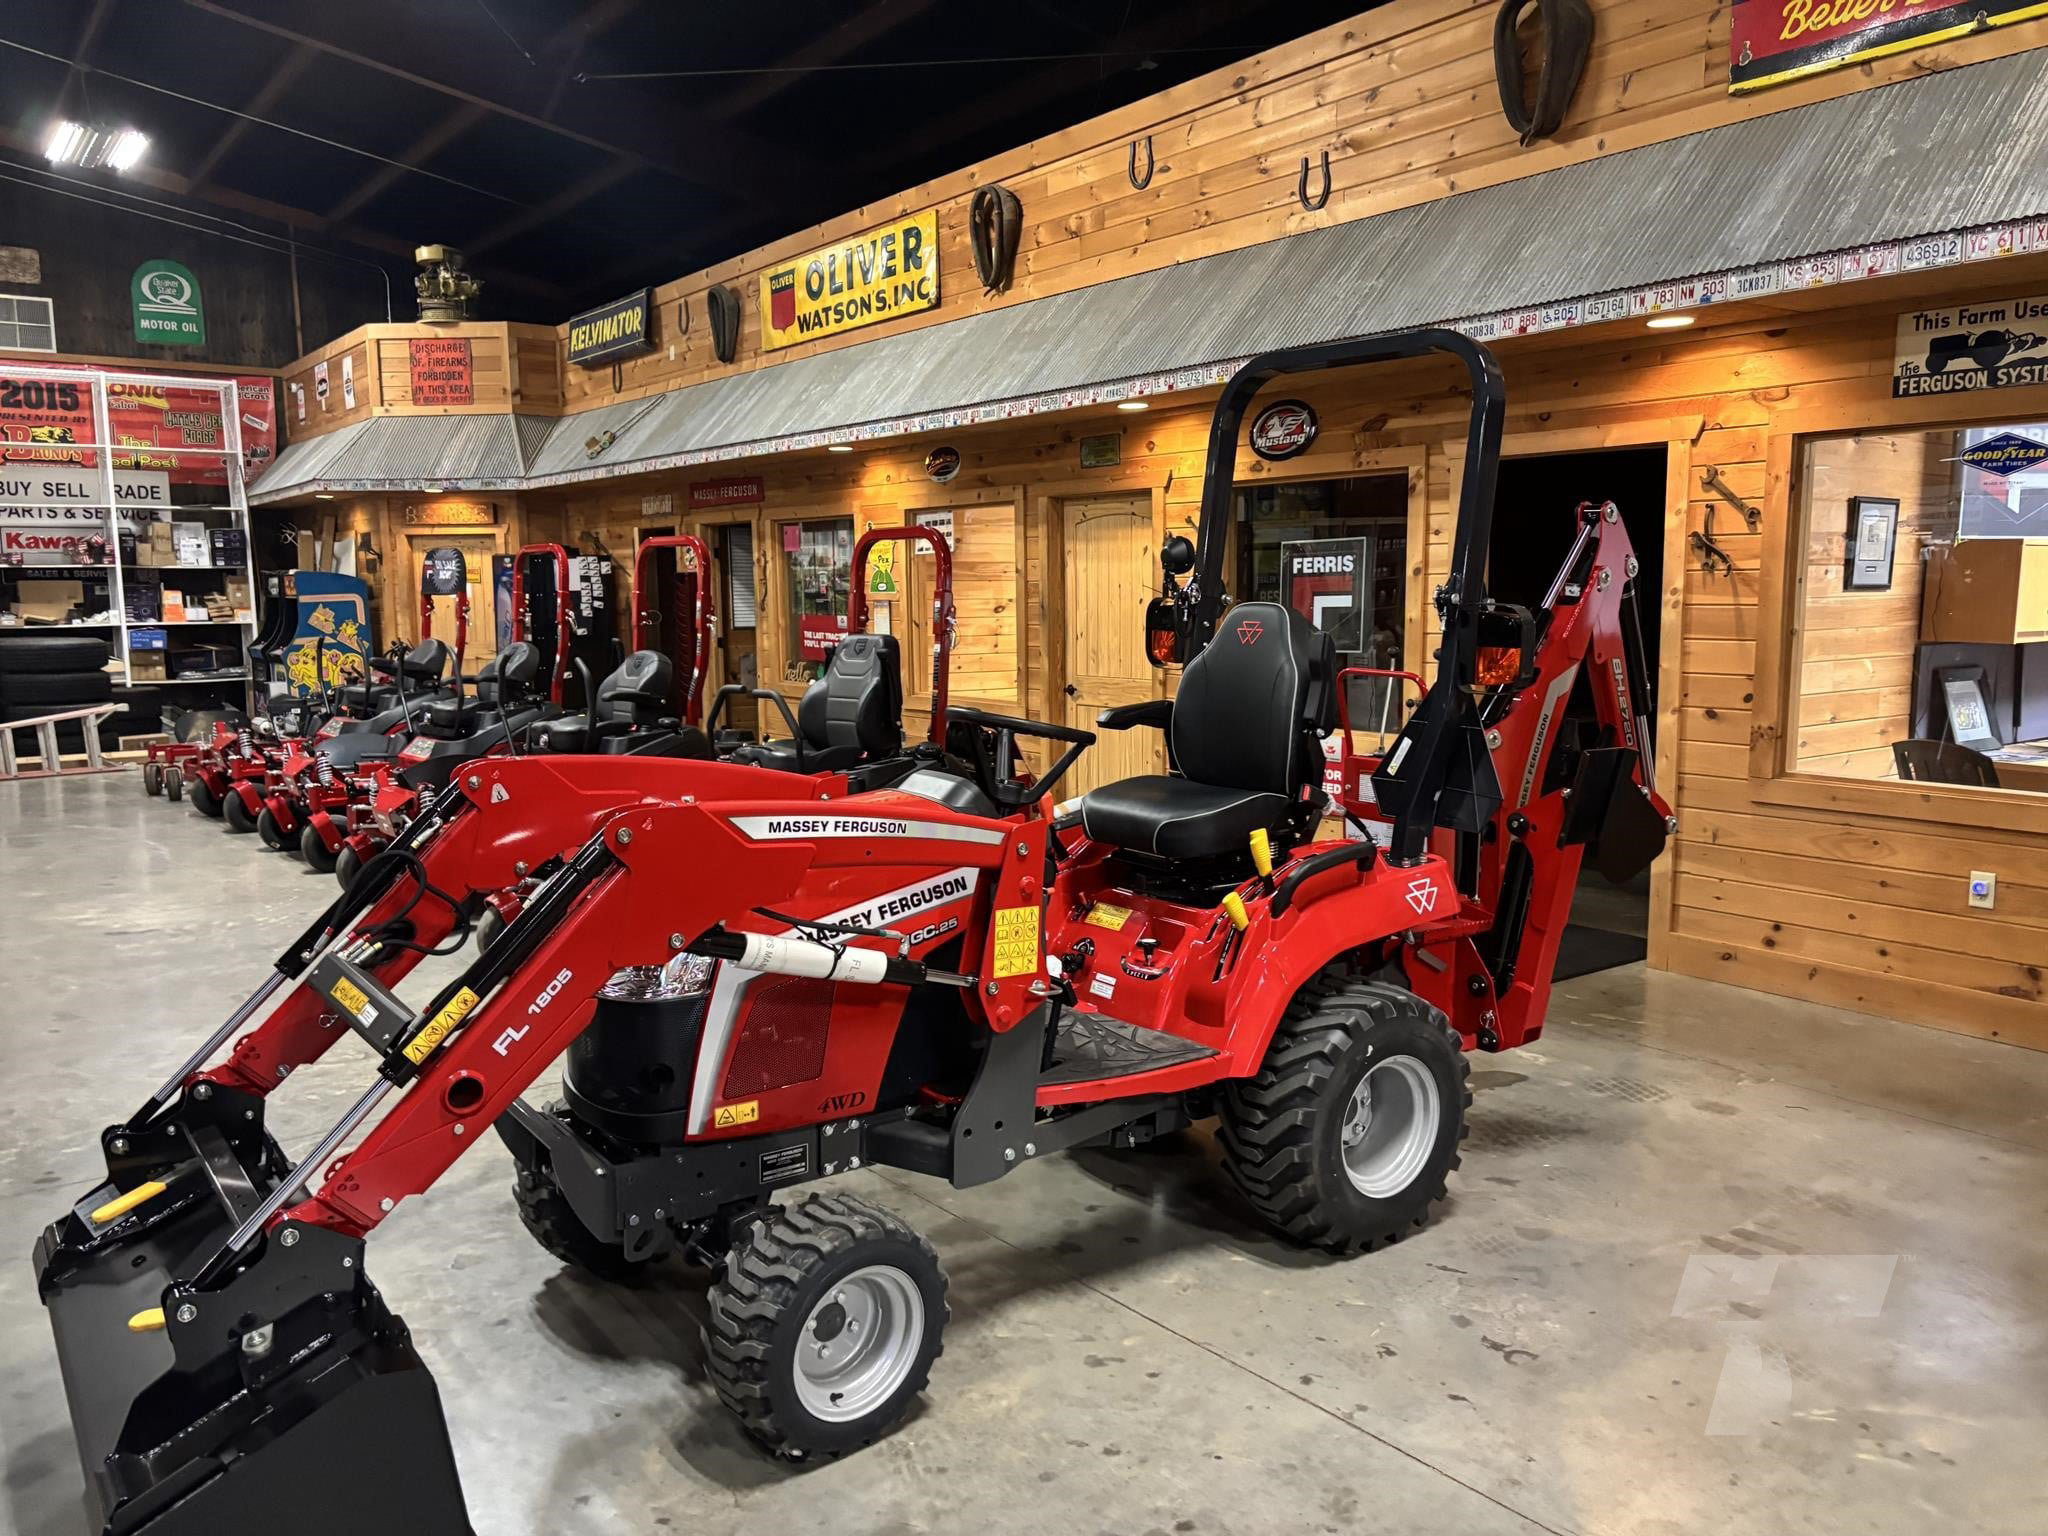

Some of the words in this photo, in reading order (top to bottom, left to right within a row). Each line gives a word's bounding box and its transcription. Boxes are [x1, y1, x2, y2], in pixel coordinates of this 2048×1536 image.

[1997, 227, 2024, 248] 611
[1906, 240, 1958, 262] 436912
[805, 226, 922, 301] OLIVER
[1811, 261, 1837, 277] 953
[771, 273, 794, 289] OLIVER
[1737, 275, 1772, 294] 3CK837
[1632, 293, 1646, 309] TW
[1653, 290, 1674, 305] 783
[1680, 284, 1695, 301] NW
[1702, 280, 1725, 296] 503
[1561, 306, 1579, 321] 051
[1587, 298, 1624, 316] 457164
[1913, 312, 1950, 331] This
[1958, 308, 2006, 326] Farm
[2014, 301, 2048, 319] Use
[140, 319, 178, 331] MOTOR
[182, 322, 199, 333] OIL
[571, 306, 642, 353] KELVINATOR
[1520, 313, 1537, 329] 888
[415, 343, 464, 354] DISCHARGE
[428, 356, 468, 367] FIREARMS
[1899, 360, 1920, 378] The
[417, 371, 464, 381] FORBIDDEN
[1899, 370, 1989, 395] FERGUSON
[1996, 364, 2048, 386] SYSTE
[0, 380, 79, 411] 2015
[108, 383, 165, 399] ONIC
[236, 384, 270, 393] erican
[428, 385, 446, 395] THIS
[449, 384, 470, 395] AREA
[1255, 432, 1307, 449] Mustang
[141, 455, 179, 468] Post
[1963, 447, 2047, 461] GOODYEAR
[43, 482, 90, 498] SELL
[114, 485, 161, 500] RADE
[64, 507, 76, 519] &
[82, 508, 159, 521] SEVICE
[1293, 554, 1355, 574] FERRIS
[27, 569, 58, 578] SALES
[73, 570, 109, 578] SERVIC
[785, 660, 812, 682] hello
[1528, 713, 1549, 776] FERGUSON
[768, 820, 829, 833] MASSEY
[834, 820, 907, 834] FERGUSON
[878, 875, 968, 924] FERGUSON
[492, 1023, 530, 1056] FL
[528, 967, 573, 1015] 1805
[817, 1091, 866, 1114] 4WD
